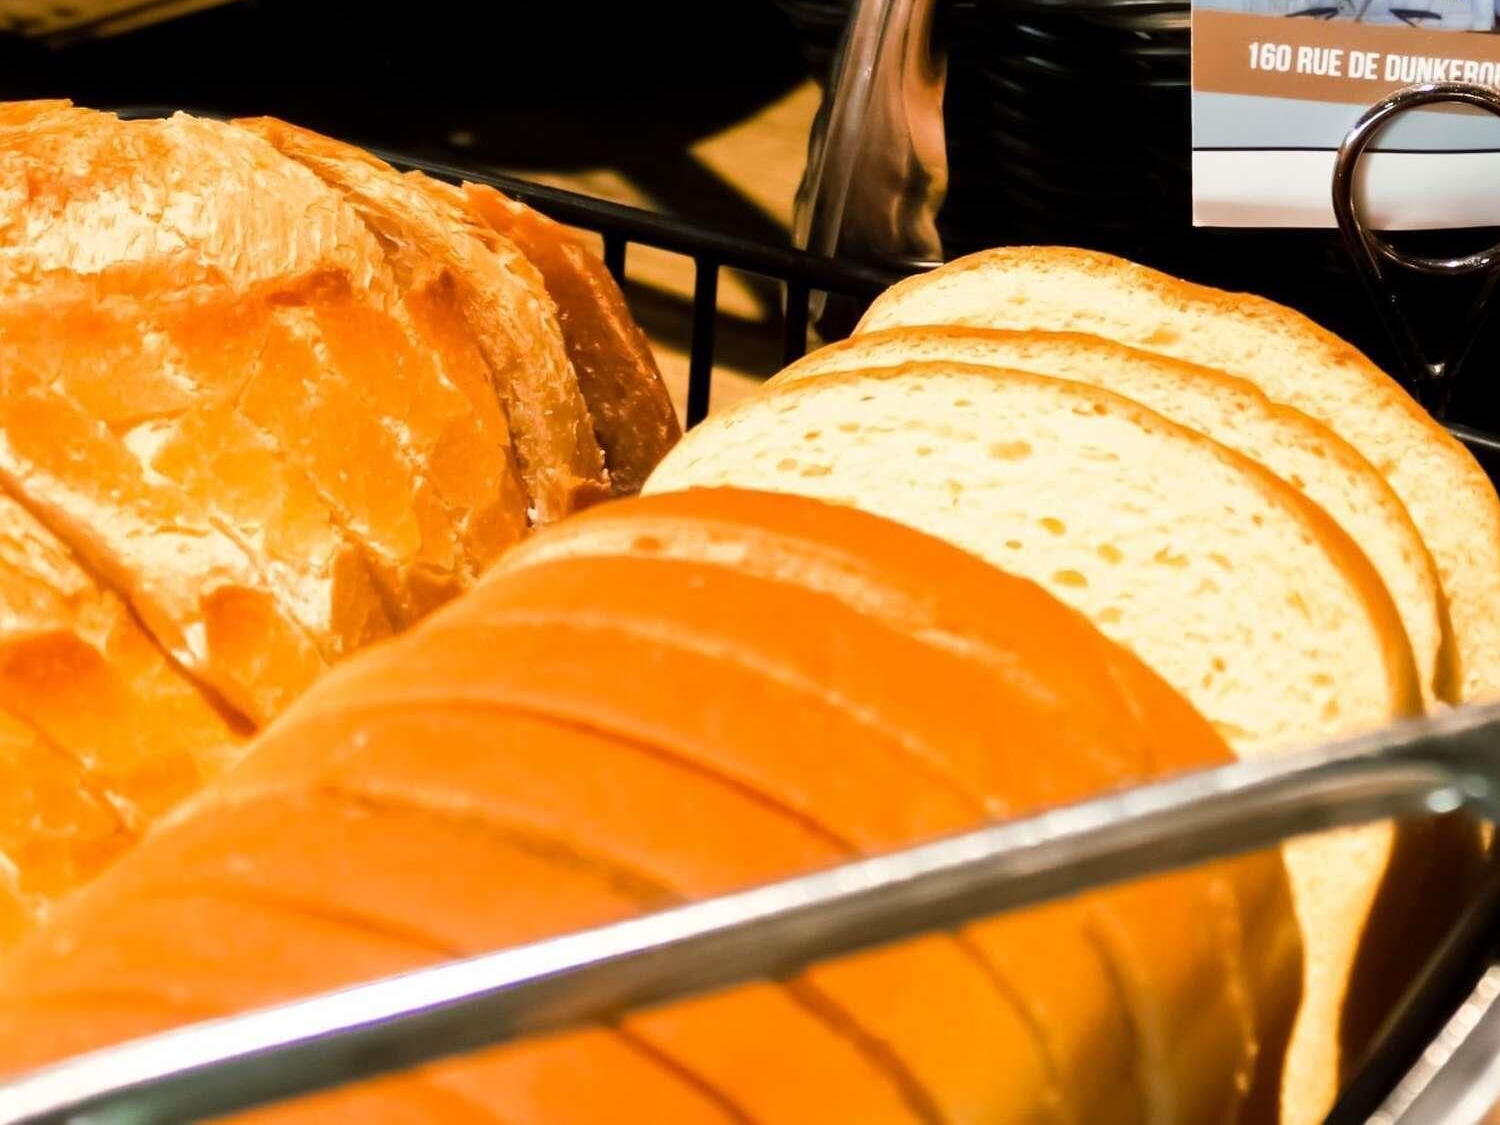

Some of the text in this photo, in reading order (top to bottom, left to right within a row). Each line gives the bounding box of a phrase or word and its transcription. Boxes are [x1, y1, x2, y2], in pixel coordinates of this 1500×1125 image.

[1249, 42, 1292, 72] 160
[1296, 46, 1344, 77] RUE
[1348, 50, 1381, 81] DE
